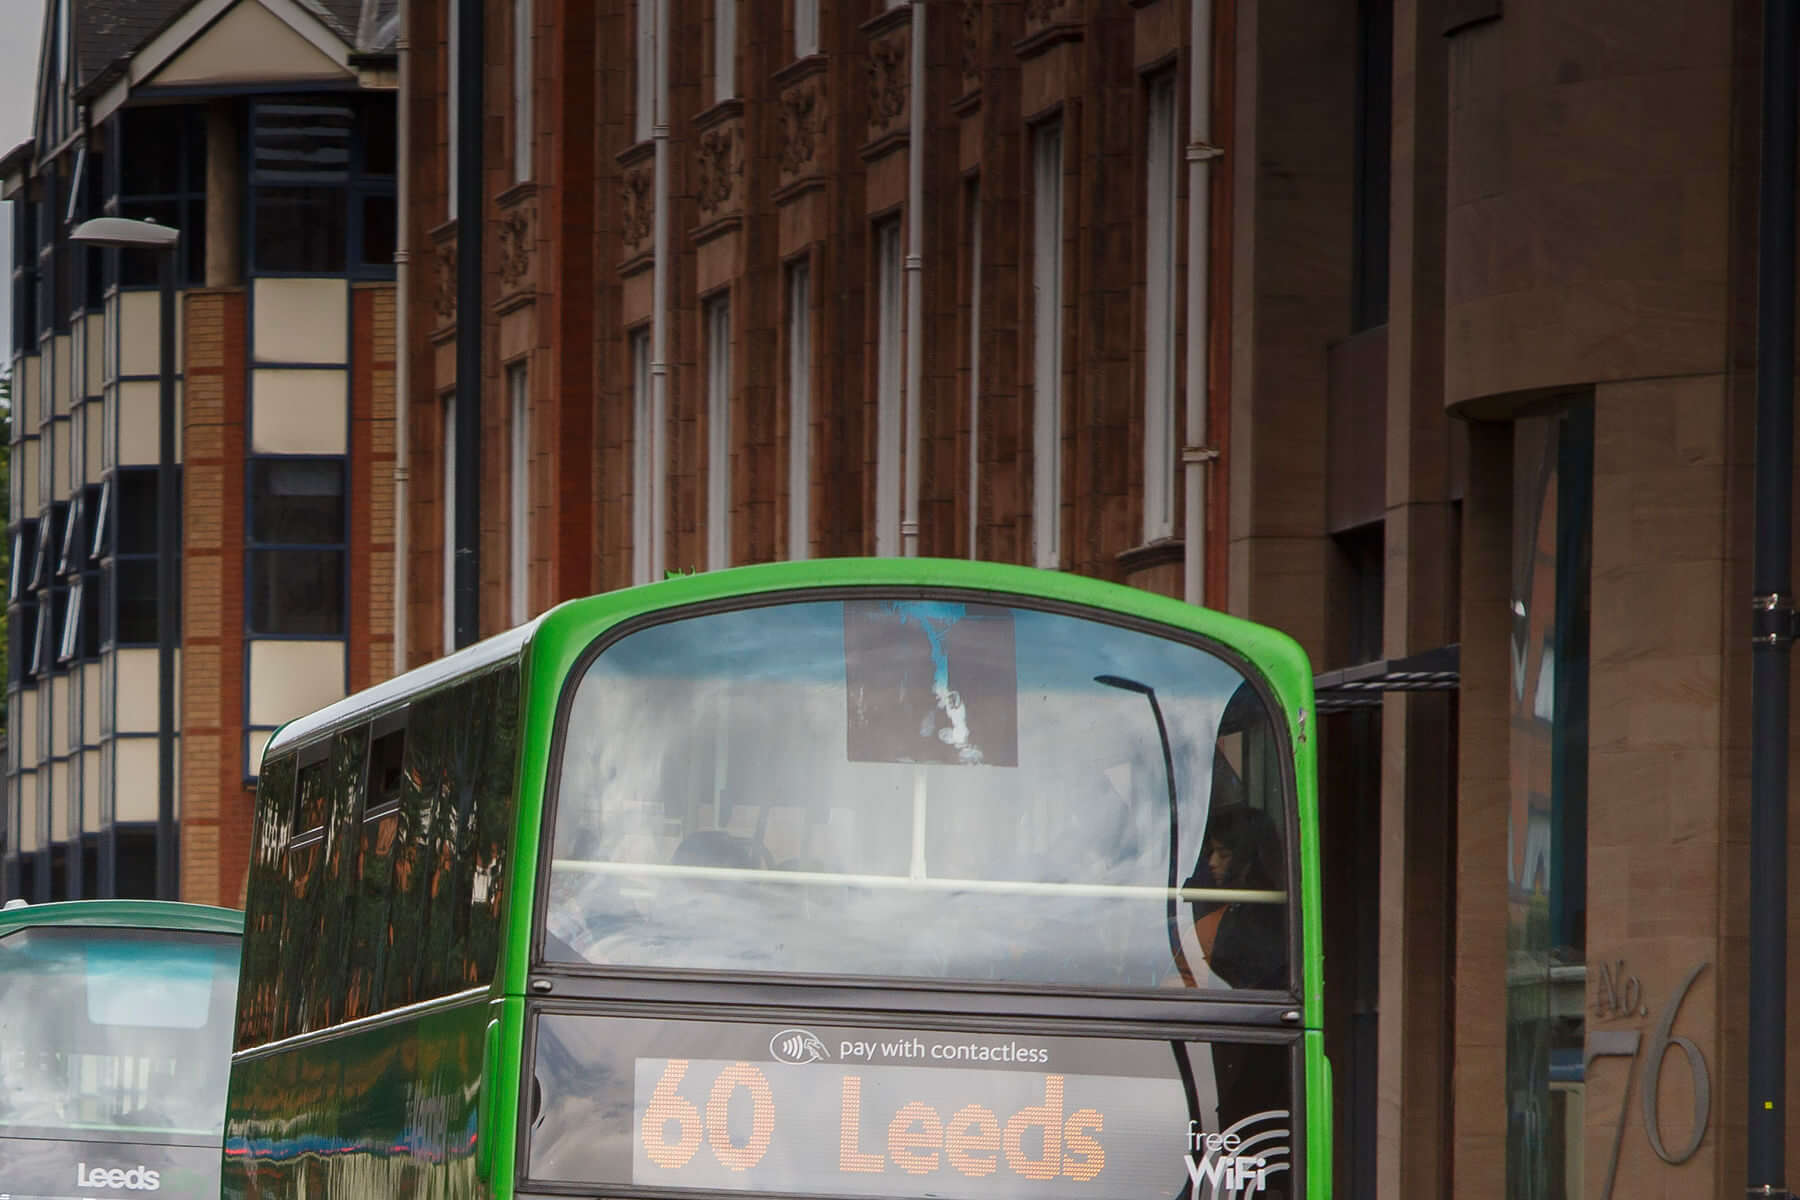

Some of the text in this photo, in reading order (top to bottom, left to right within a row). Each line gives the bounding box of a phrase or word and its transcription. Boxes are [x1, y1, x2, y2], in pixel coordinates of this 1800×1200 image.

[839, 1038, 1049, 1063] pay with contactless
[640, 1059, 1106, 1181] 60 Leeds
[1185, 1120, 1241, 1152] free
[77, 1163, 160, 1190] Leeds
[1183, 1154, 1266, 1191] WiFi
